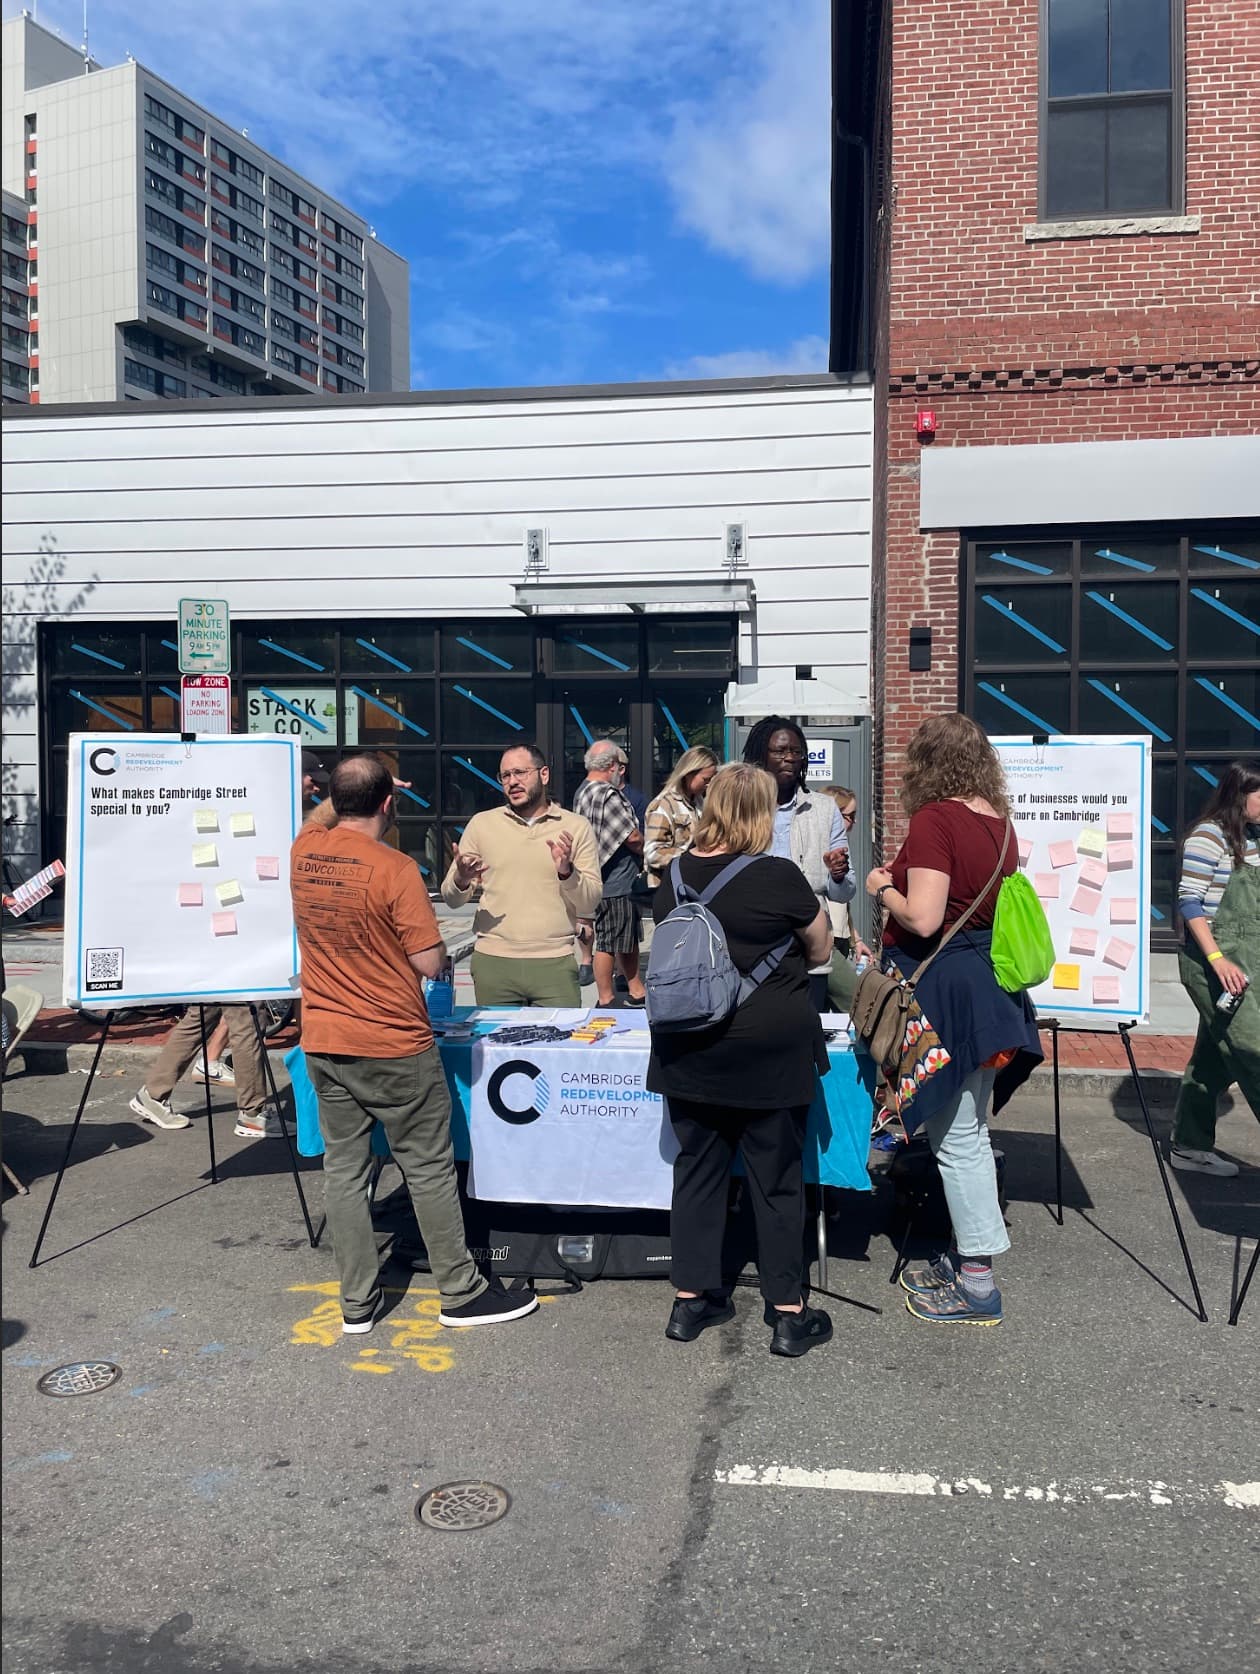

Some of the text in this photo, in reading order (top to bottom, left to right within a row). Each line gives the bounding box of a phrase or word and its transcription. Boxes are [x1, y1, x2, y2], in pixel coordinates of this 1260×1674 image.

[194, 604, 214, 616] 30
[186, 618, 222, 629] MINUTE
[183, 630, 226, 640] PARKING
[186, 677, 226, 687] TOW ZONE
[201, 690, 211, 698] NO
[191, 700, 221, 708] PARKING
[249, 698, 316, 716] STACK
[91, 786, 247, 801] What makes Cambridge Street
[1018, 793, 1026, 804] of
[1030, 793, 1078, 804] businesses
[1082, 793, 1108, 804] would
[1111, 794, 1128, 805] you
[90, 802, 170, 817] special to you?
[1014, 811, 1036, 821] more
[1040, 811, 1050, 821] on
[1053, 810, 1100, 823] Cambridge
[560, 1072, 642, 1086] CAMBRIDGE
[560, 1088, 663, 1102] REDEVELOPME
[560, 1104, 639, 1118] AUTHORITY
